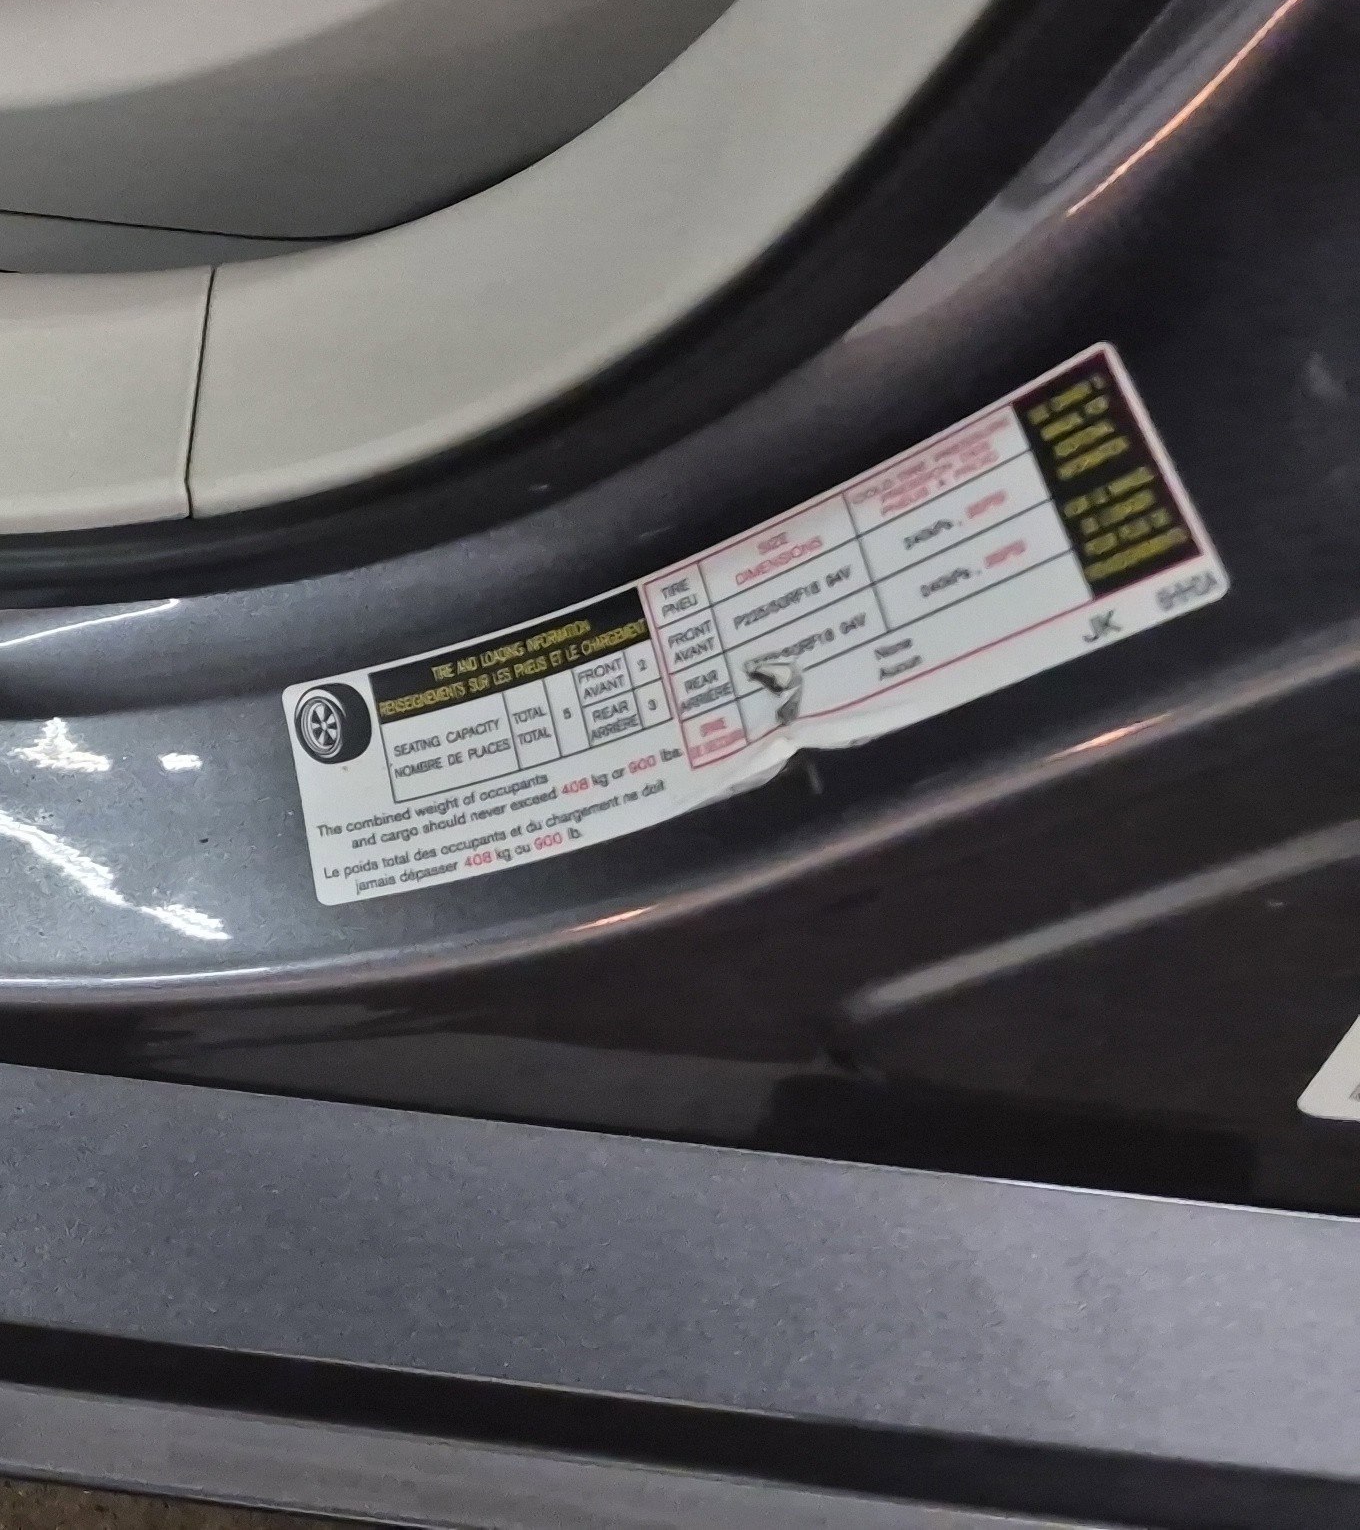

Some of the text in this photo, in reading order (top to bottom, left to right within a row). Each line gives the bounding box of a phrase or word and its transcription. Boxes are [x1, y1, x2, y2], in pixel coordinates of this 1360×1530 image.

[668, 619, 711, 648] FRONT
[431, 620, 592, 681] TIRE AND LOADING INFORMATION
[637, 658, 647, 672] 2
[674, 637, 715, 664] AVANT
[468, 675, 490, 692] SUR
[492, 667, 511, 686] LES
[513, 657, 547, 678] PNEUS
[550, 651, 563, 667] ET
[565, 645, 580, 662] LE
[580, 658, 623, 682] FRONT
[684, 670, 719, 692] REAR
[582, 675, 626, 700] AVANT
[513, 705, 546, 725] TOTAL
[592, 700, 629, 721] REAR
[393, 719, 500, 757] SEATING CAPACITY
[517, 726, 551, 745] TOTAL
[394, 738, 511, 779] NOMBRE DE PLACES
[316, 773, 549, 837] The combined weight of occupants
[351, 833, 377, 849] and
[380, 826, 419, 842] cargo
[422, 812, 466, 834] should
[470, 803, 507, 822] never
[510, 787, 558, 811] exceed
[561, 777, 590, 795] 408
[591, 773, 609, 788] kg
[611, 768, 625, 780] or
[323, 779, 666, 879] Le poids total des occupants et du chargement ne doit
[356, 874, 396, 895] jamais
[464, 851, 492, 867] 408
[495, 847, 511, 862] kg
[514, 843, 531, 855] ou
